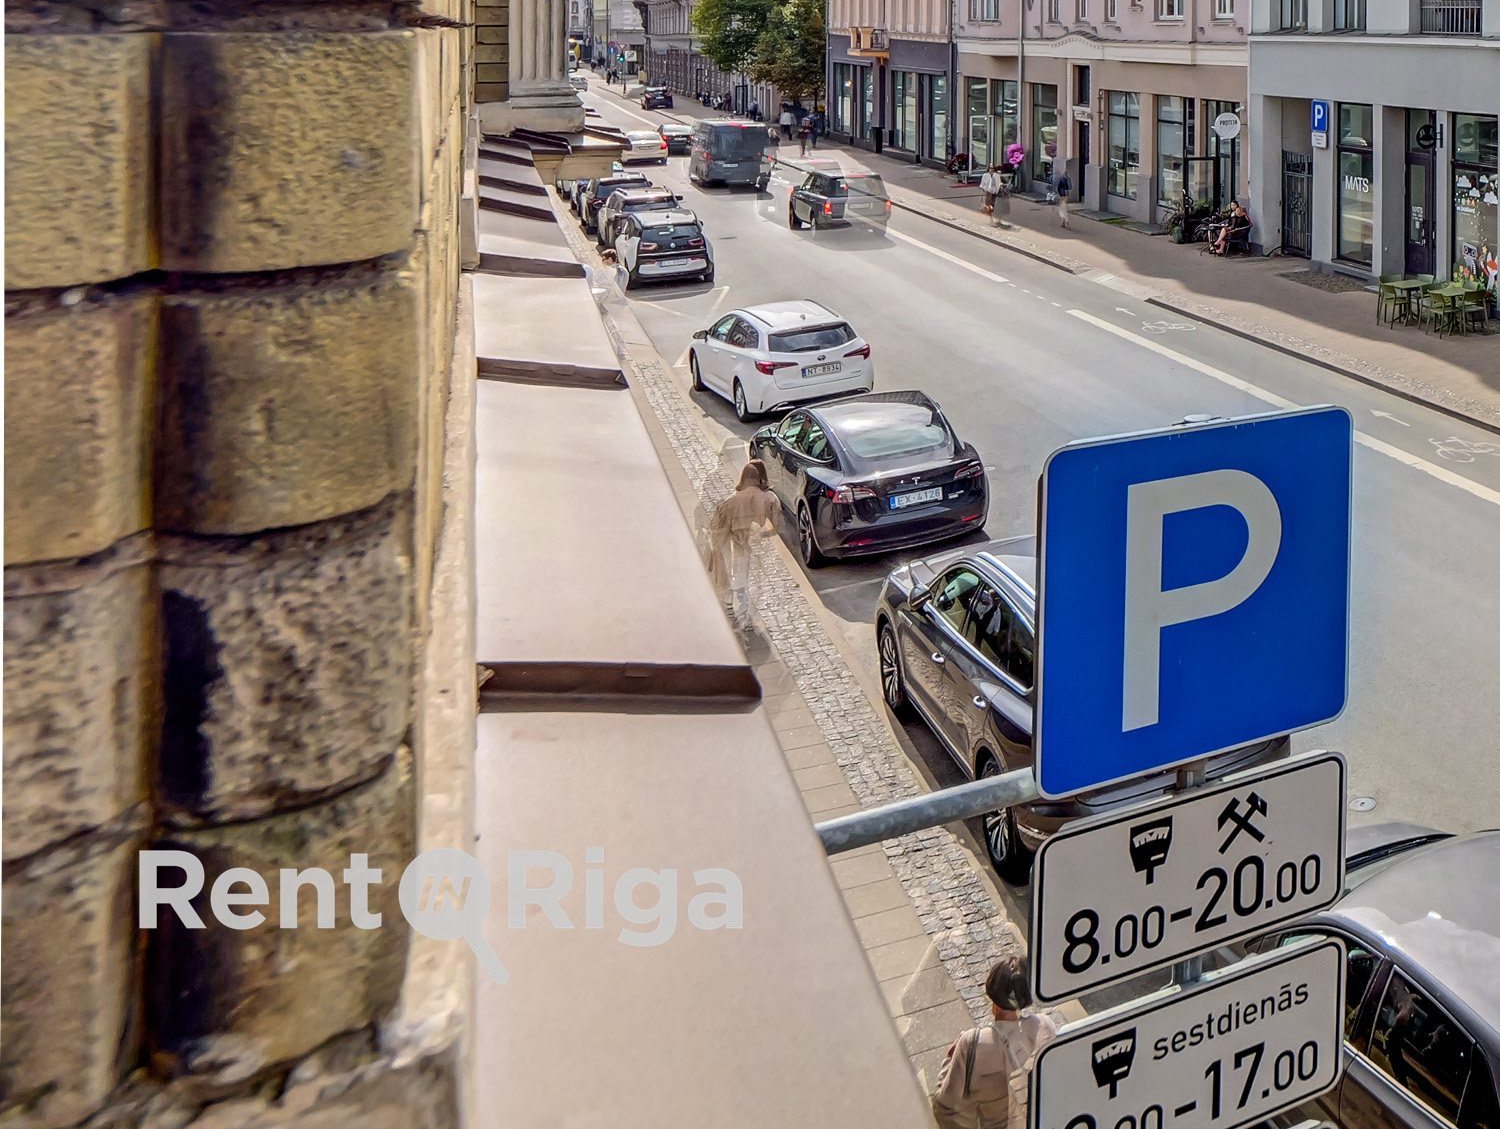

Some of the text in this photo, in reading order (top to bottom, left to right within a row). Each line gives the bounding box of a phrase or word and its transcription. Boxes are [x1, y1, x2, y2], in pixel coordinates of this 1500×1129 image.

[1314, 104, 1324, 127] P
[1345, 175, 1369, 193] MATS
[1121, 469, 1282, 732] P
[1062, 854, 1321, 974] 8.00-20.00
[1152, 982, 1310, 1060] sestdienās
[1064, 1040, 1318, 1129] 0-17.00
